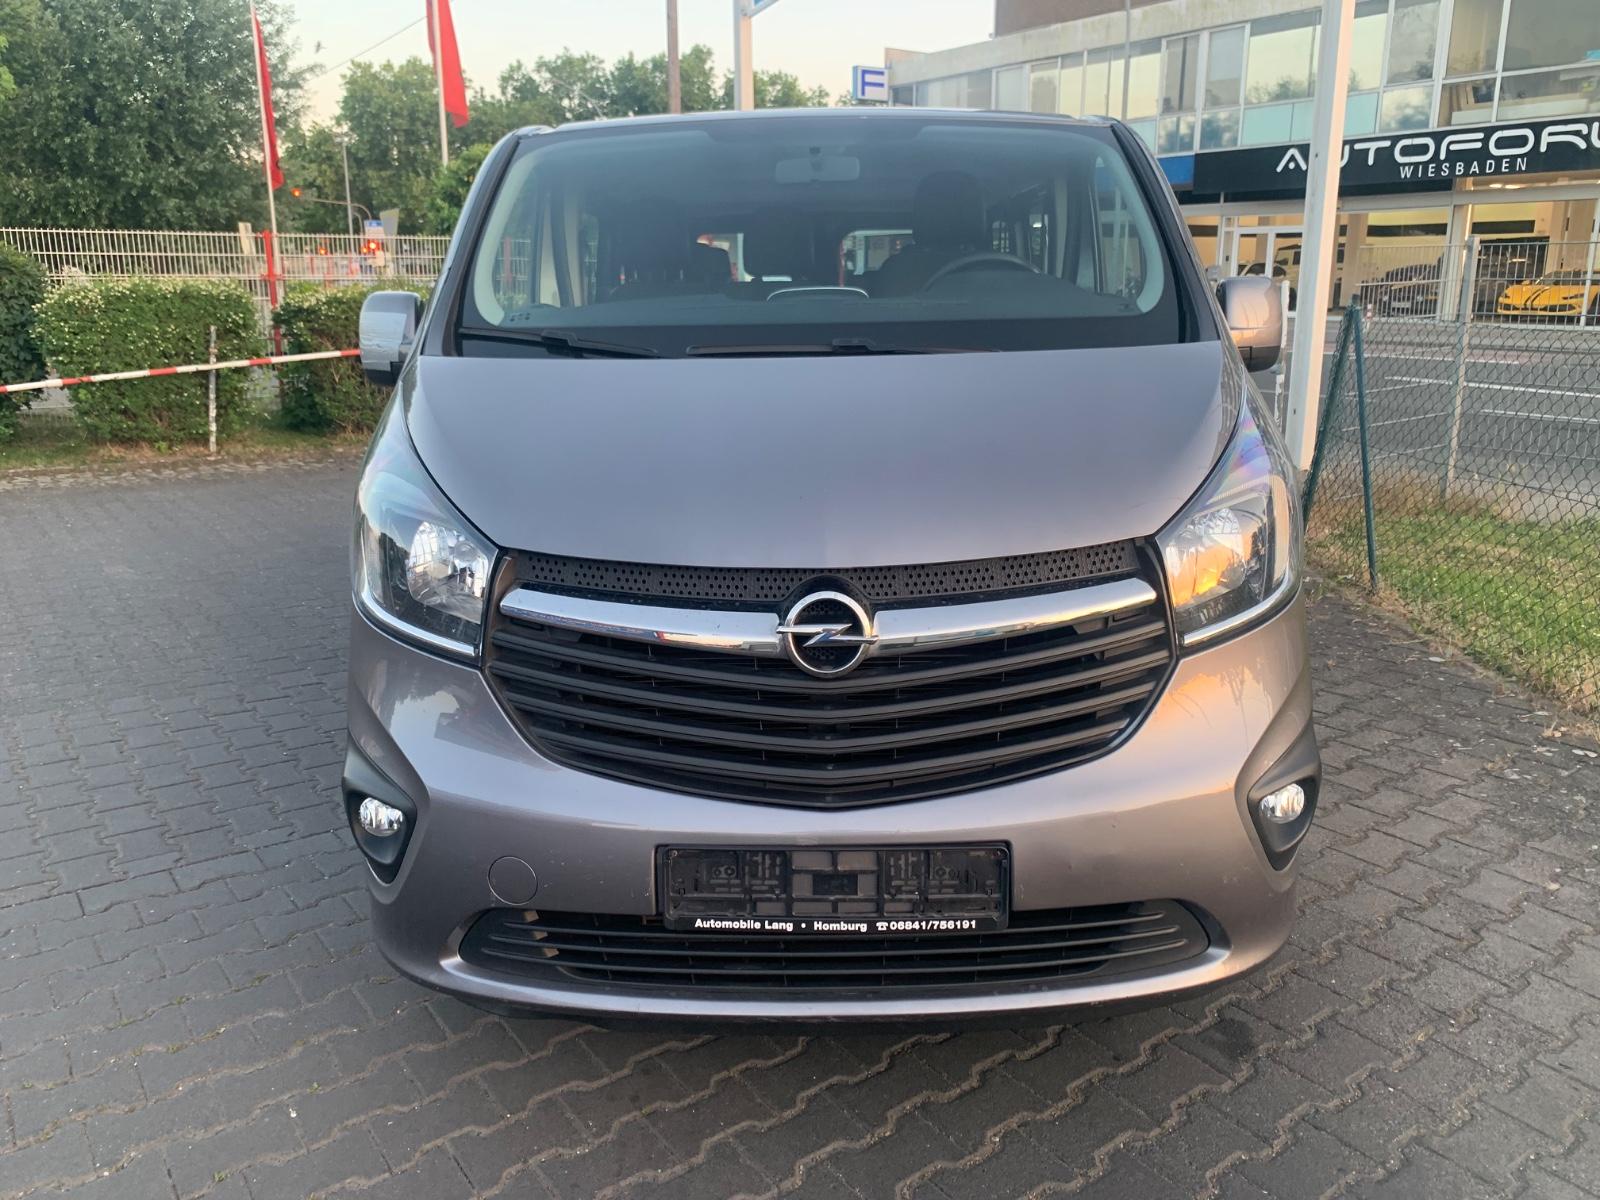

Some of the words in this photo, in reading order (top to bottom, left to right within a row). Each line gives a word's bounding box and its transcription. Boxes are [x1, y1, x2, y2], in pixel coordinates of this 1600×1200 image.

[861, 69, 885, 97] F
[1276, 121, 1600, 173] ATOFOR
[1400, 157, 1527, 179] WIESBADEN
[694, 918, 761, 930] Automobile
[764, 920, 794, 932] Lang
[813, 920, 868, 932] Homburg
